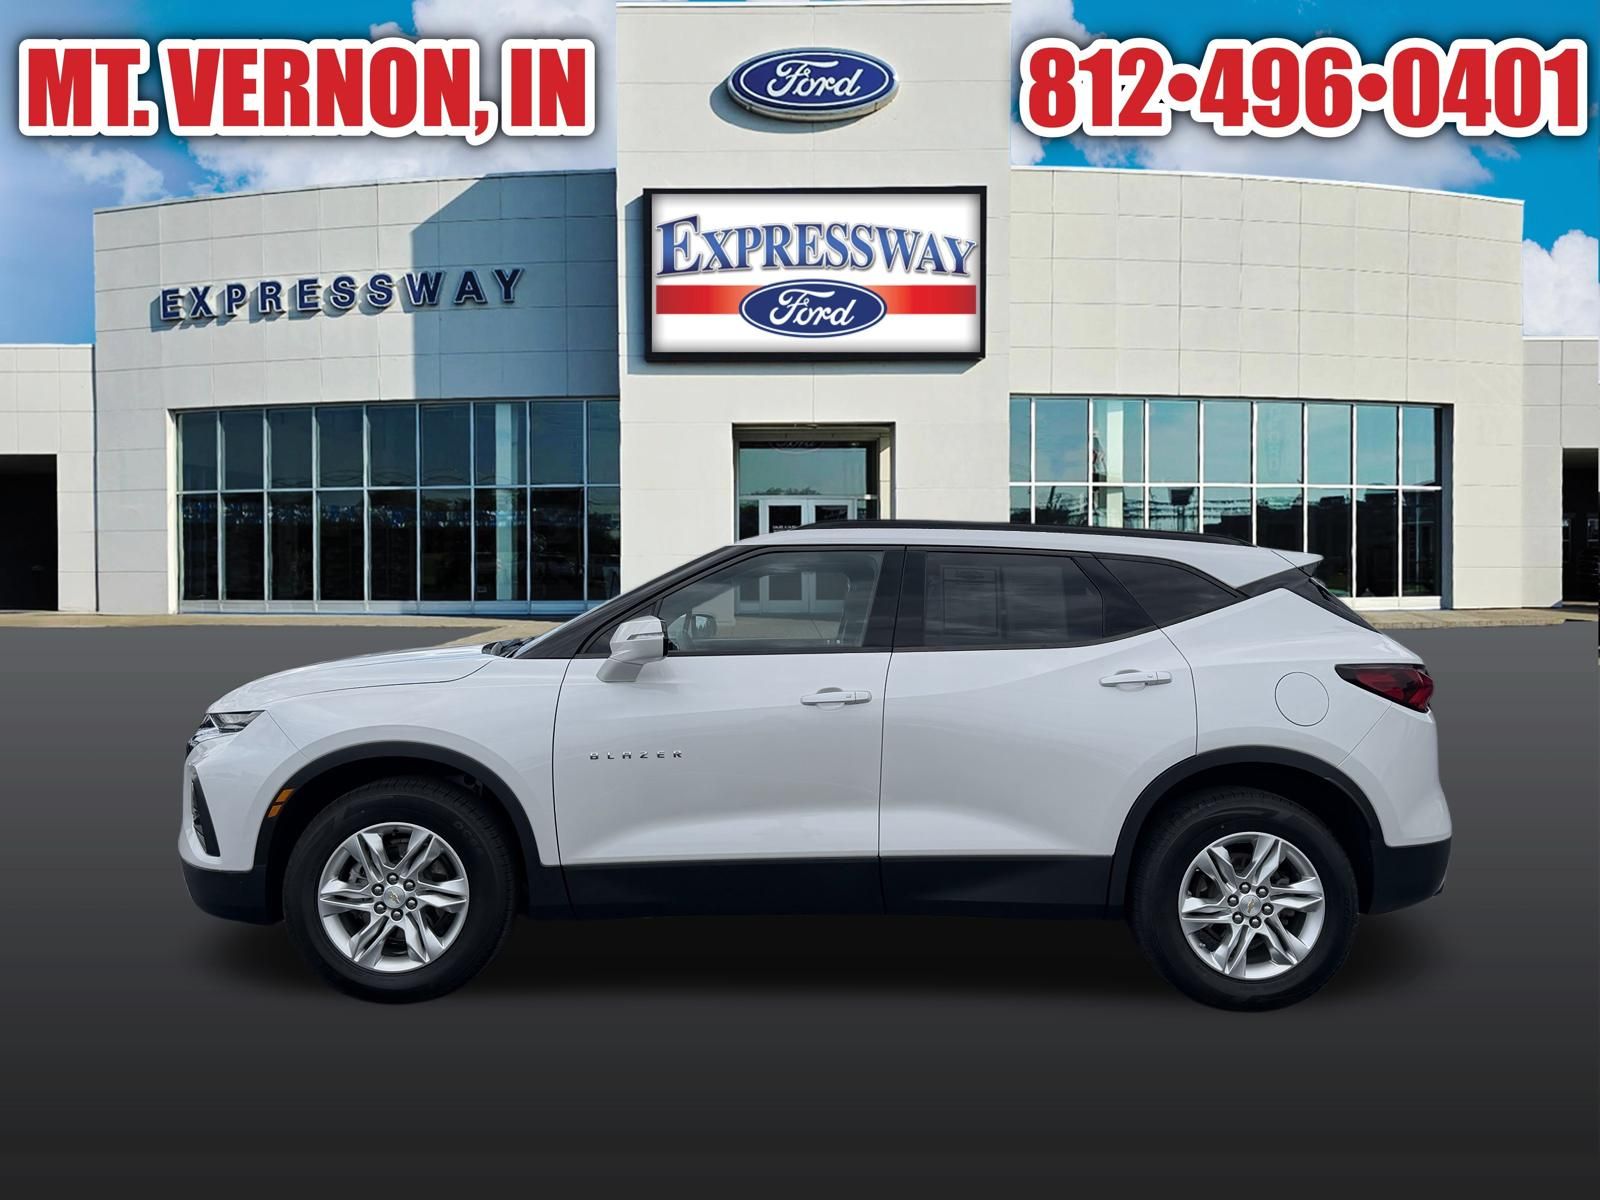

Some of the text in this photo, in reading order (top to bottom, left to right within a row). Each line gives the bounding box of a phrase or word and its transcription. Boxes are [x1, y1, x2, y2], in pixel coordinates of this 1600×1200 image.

[766, 59, 864, 98] Ford
[160, 267, 525, 321] EXPRESSWAY
[769, 288, 858, 326] Ford
[589, 751, 682, 760] BLAZER
